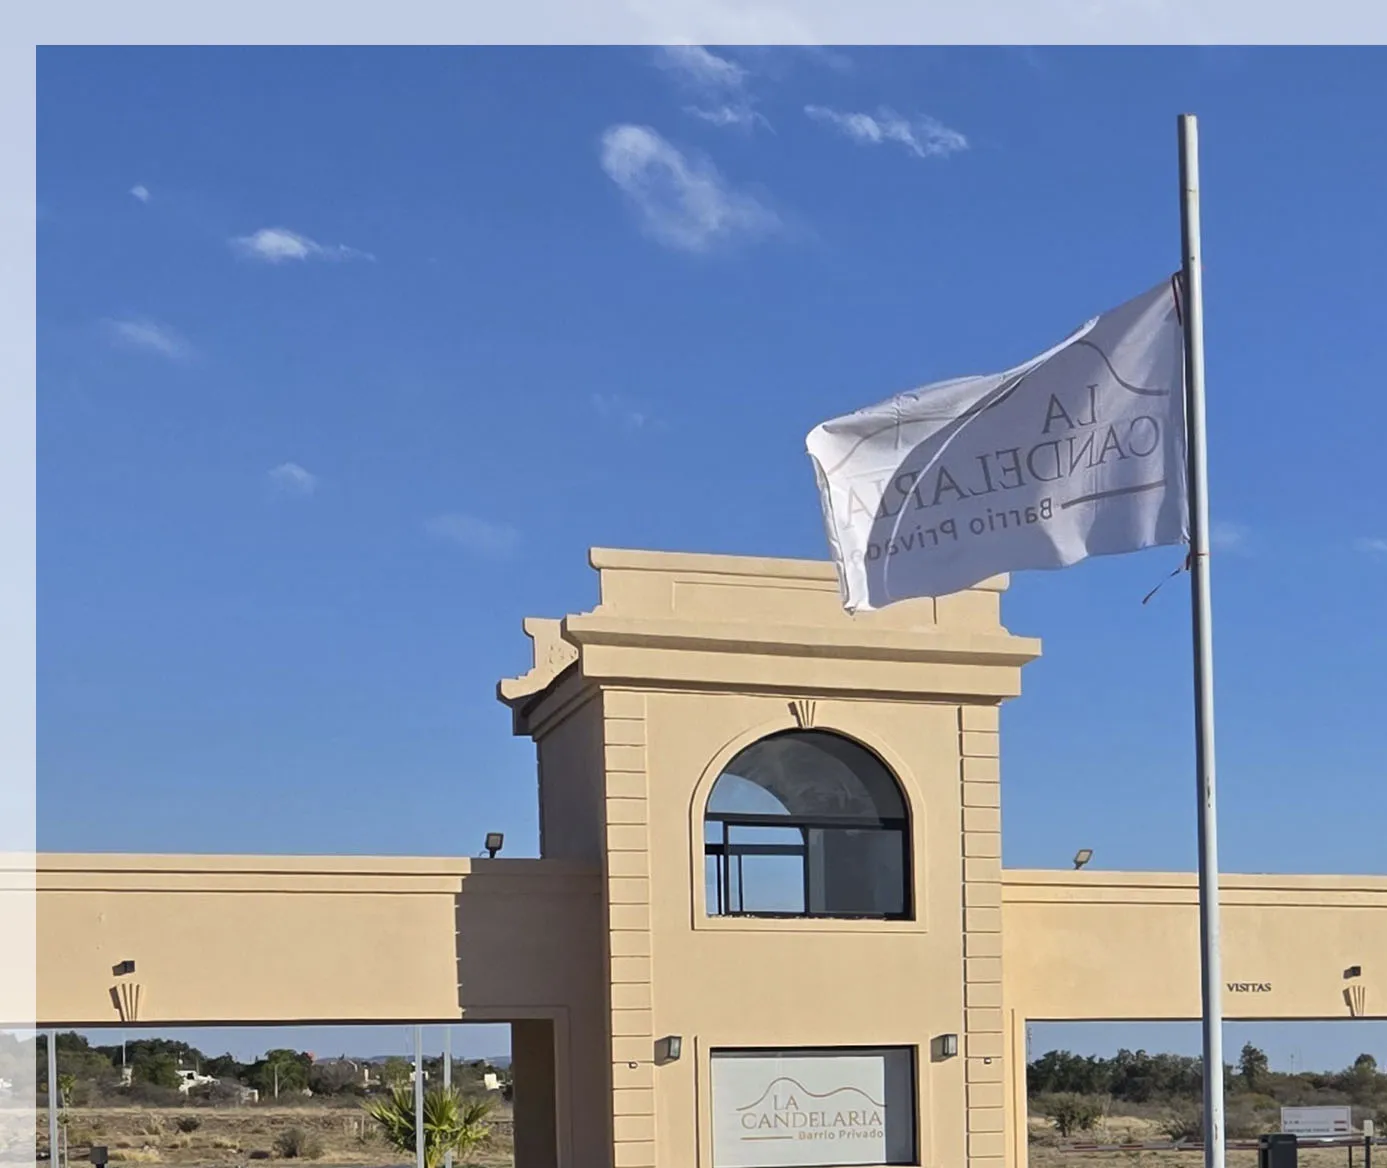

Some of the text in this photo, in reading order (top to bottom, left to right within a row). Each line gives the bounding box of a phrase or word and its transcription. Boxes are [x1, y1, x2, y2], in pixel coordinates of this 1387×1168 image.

[1227, 982, 1272, 994] VISITAS
[774, 1094, 799, 1112] LA
[741, 1111, 882, 1130] CANDELARIA
[798, 1128, 884, 1141] Barrio Privado
